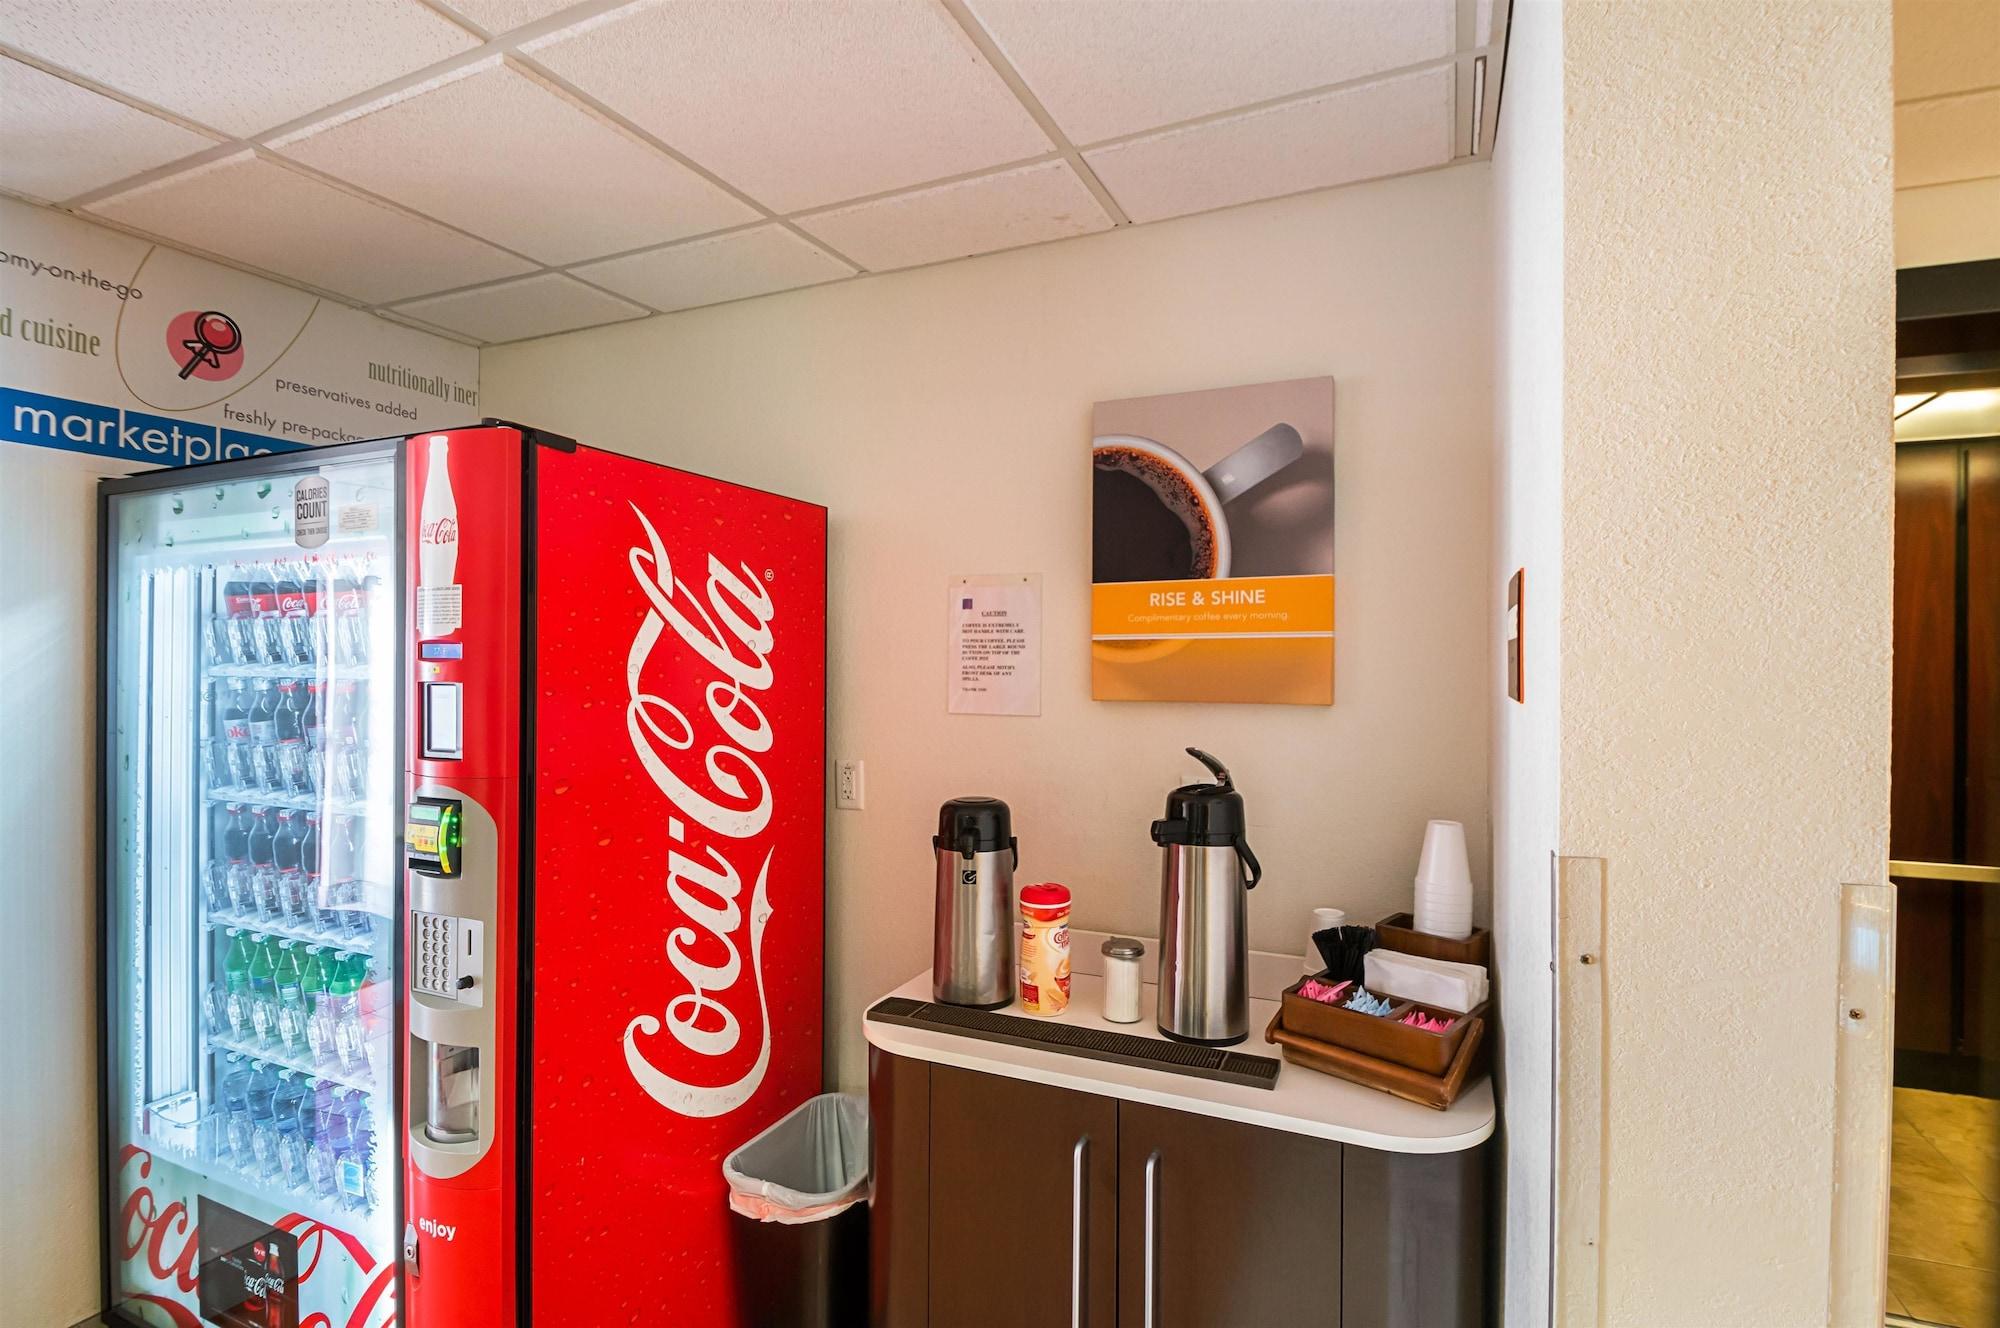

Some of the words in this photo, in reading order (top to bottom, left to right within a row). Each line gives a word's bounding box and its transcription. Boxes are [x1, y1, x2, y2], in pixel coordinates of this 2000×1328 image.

[20, 318, 101, 357] cuisine
[276, 378, 371, 410] preservatives
[375, 401, 418, 420] added
[368, 361, 450, 402] nutritionally
[14, 405, 273, 465] marketpla
[223, 403, 277, 432] freshly
[282, 420, 364, 442] pre-packa
[296, 486, 328, 503] CALORIES
[296, 500, 328, 520] COUNT
[1149, 592, 1186, 607] RISE
[1192, 591, 1205, 606] &
[1211, 589, 1266, 606] SHINE
[1127, 613, 1192, 625] Complimentary
[1193, 611, 1221, 621] coffee
[1223, 612, 1247, 622] every
[624, 499, 774, 1118] Coca-Cola
[419, 1217, 457, 1242] enjoy
